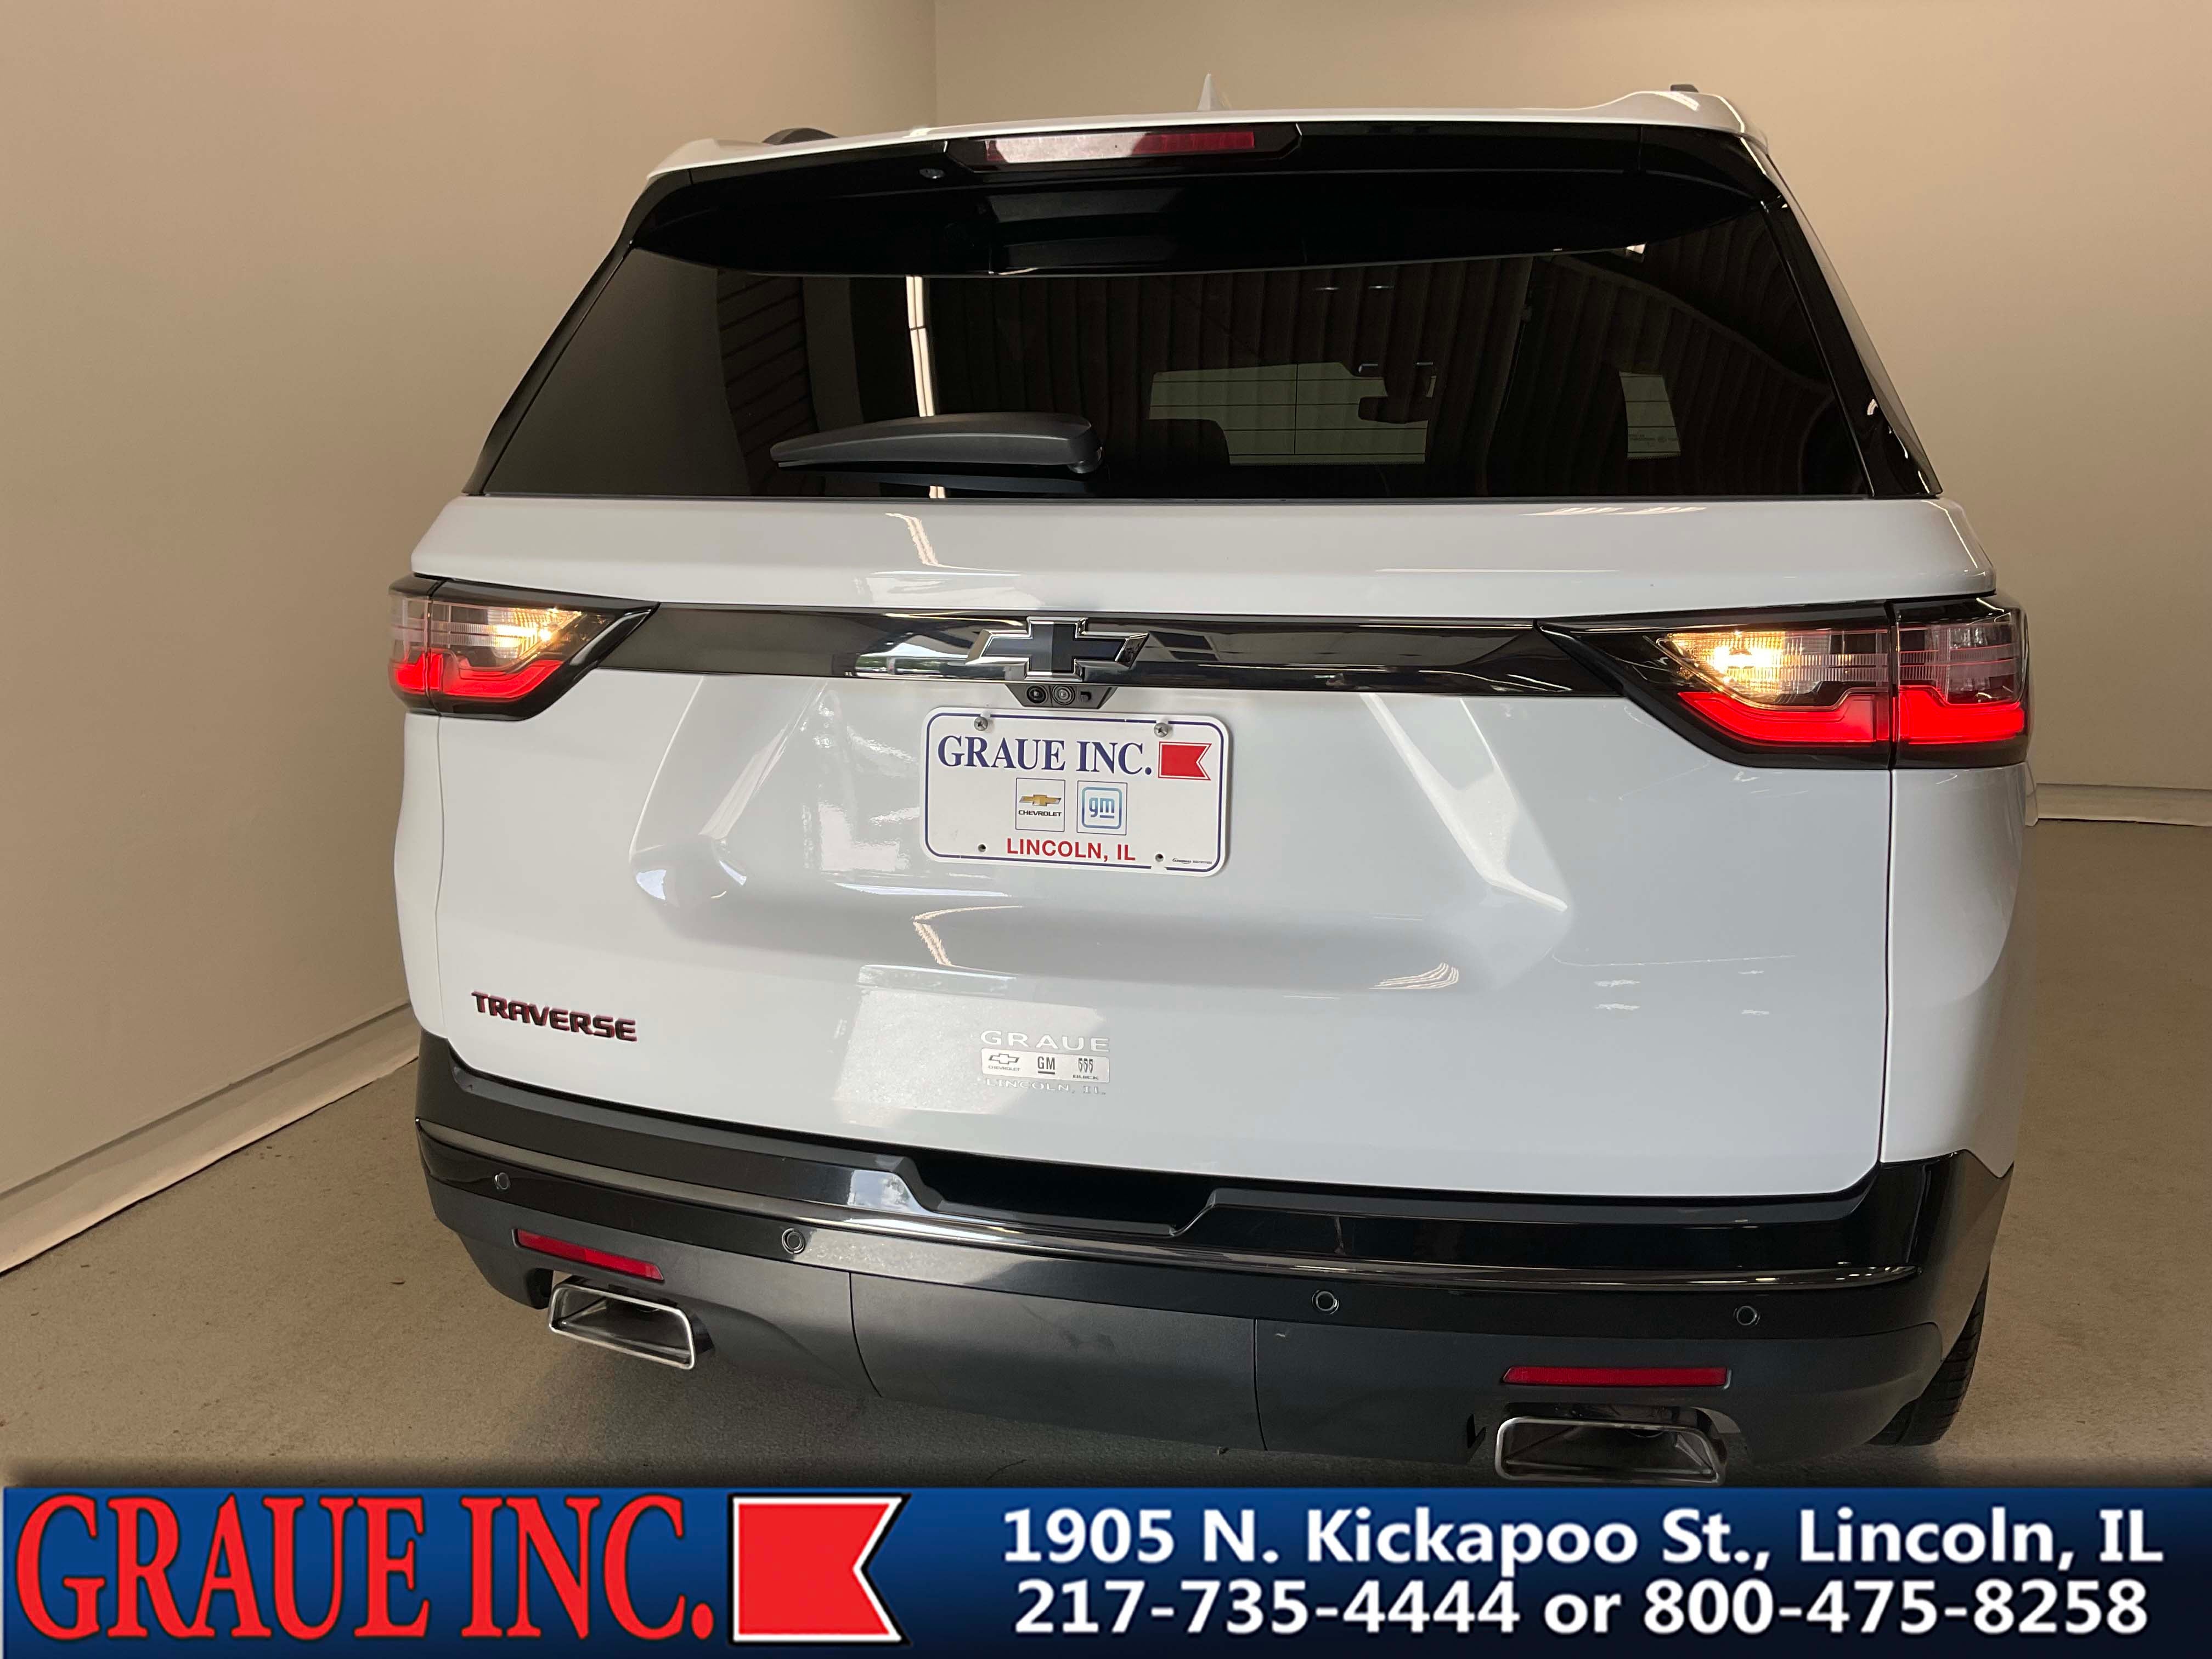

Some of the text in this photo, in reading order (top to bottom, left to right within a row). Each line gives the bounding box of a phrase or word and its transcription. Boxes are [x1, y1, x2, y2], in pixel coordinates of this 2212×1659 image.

[938, 735, 1152, 776] GRAUE INC.
[1089, 798, 1115, 819] gm
[1007, 838, 1136, 862] LINCOLN, IL
[471, 990, 637, 1042] TRAVERSE
[980, 1030, 1109, 1052] GRAUE
[1037, 1056, 1056, 1070] GM
